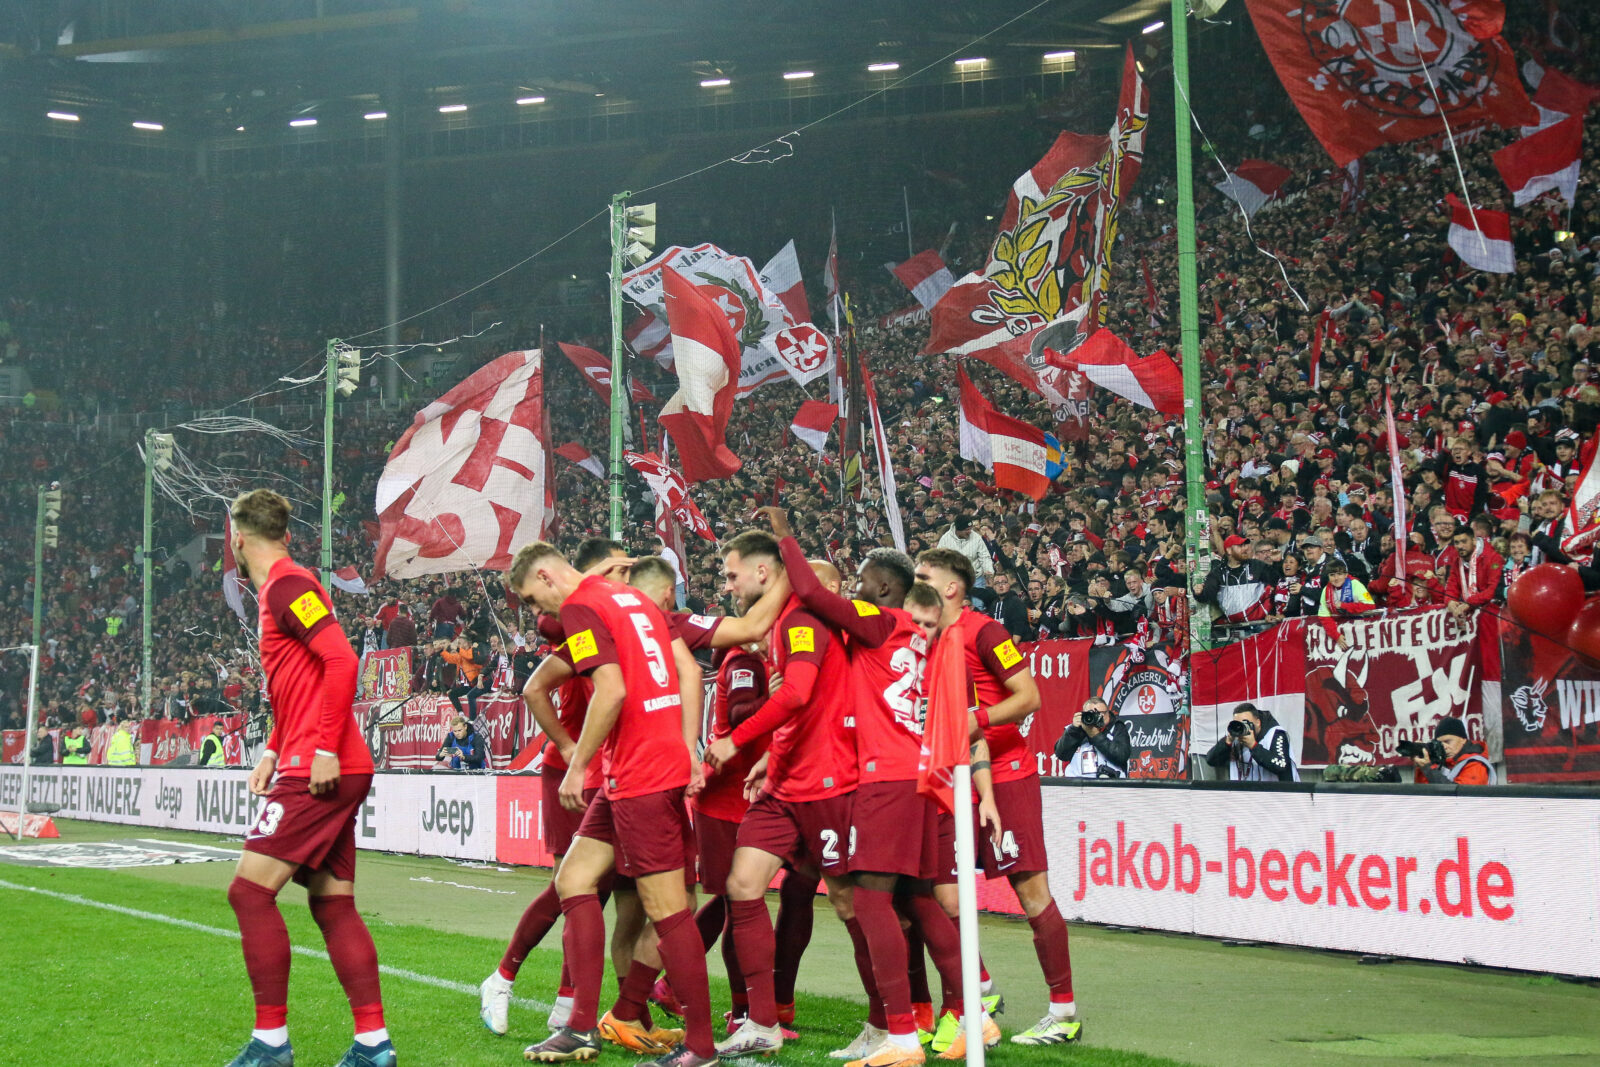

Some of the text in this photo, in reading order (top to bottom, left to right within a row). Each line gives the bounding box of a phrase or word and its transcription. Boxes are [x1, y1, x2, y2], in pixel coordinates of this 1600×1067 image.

[738, 356, 778, 378] oten
[302, 606, 321, 621] LOTTO
[573, 644, 593, 657] LOTTO
[629, 613, 669, 688] 5
[1002, 652, 1018, 664] LOTTO
[1022, 644, 1070, 679] ion
[61, 775, 82, 811] BEI
[86, 776, 142, 816] NAUERZ
[155, 777, 182, 820] Jeep
[196, 779, 275, 825] NAUER
[362, 786, 377, 838] E
[422, 785, 474, 846] Jeep
[509, 799, 533, 840] Ihr
[990, 830, 1019, 862] 14
[1073, 820, 1515, 921] jakob-becker.de
